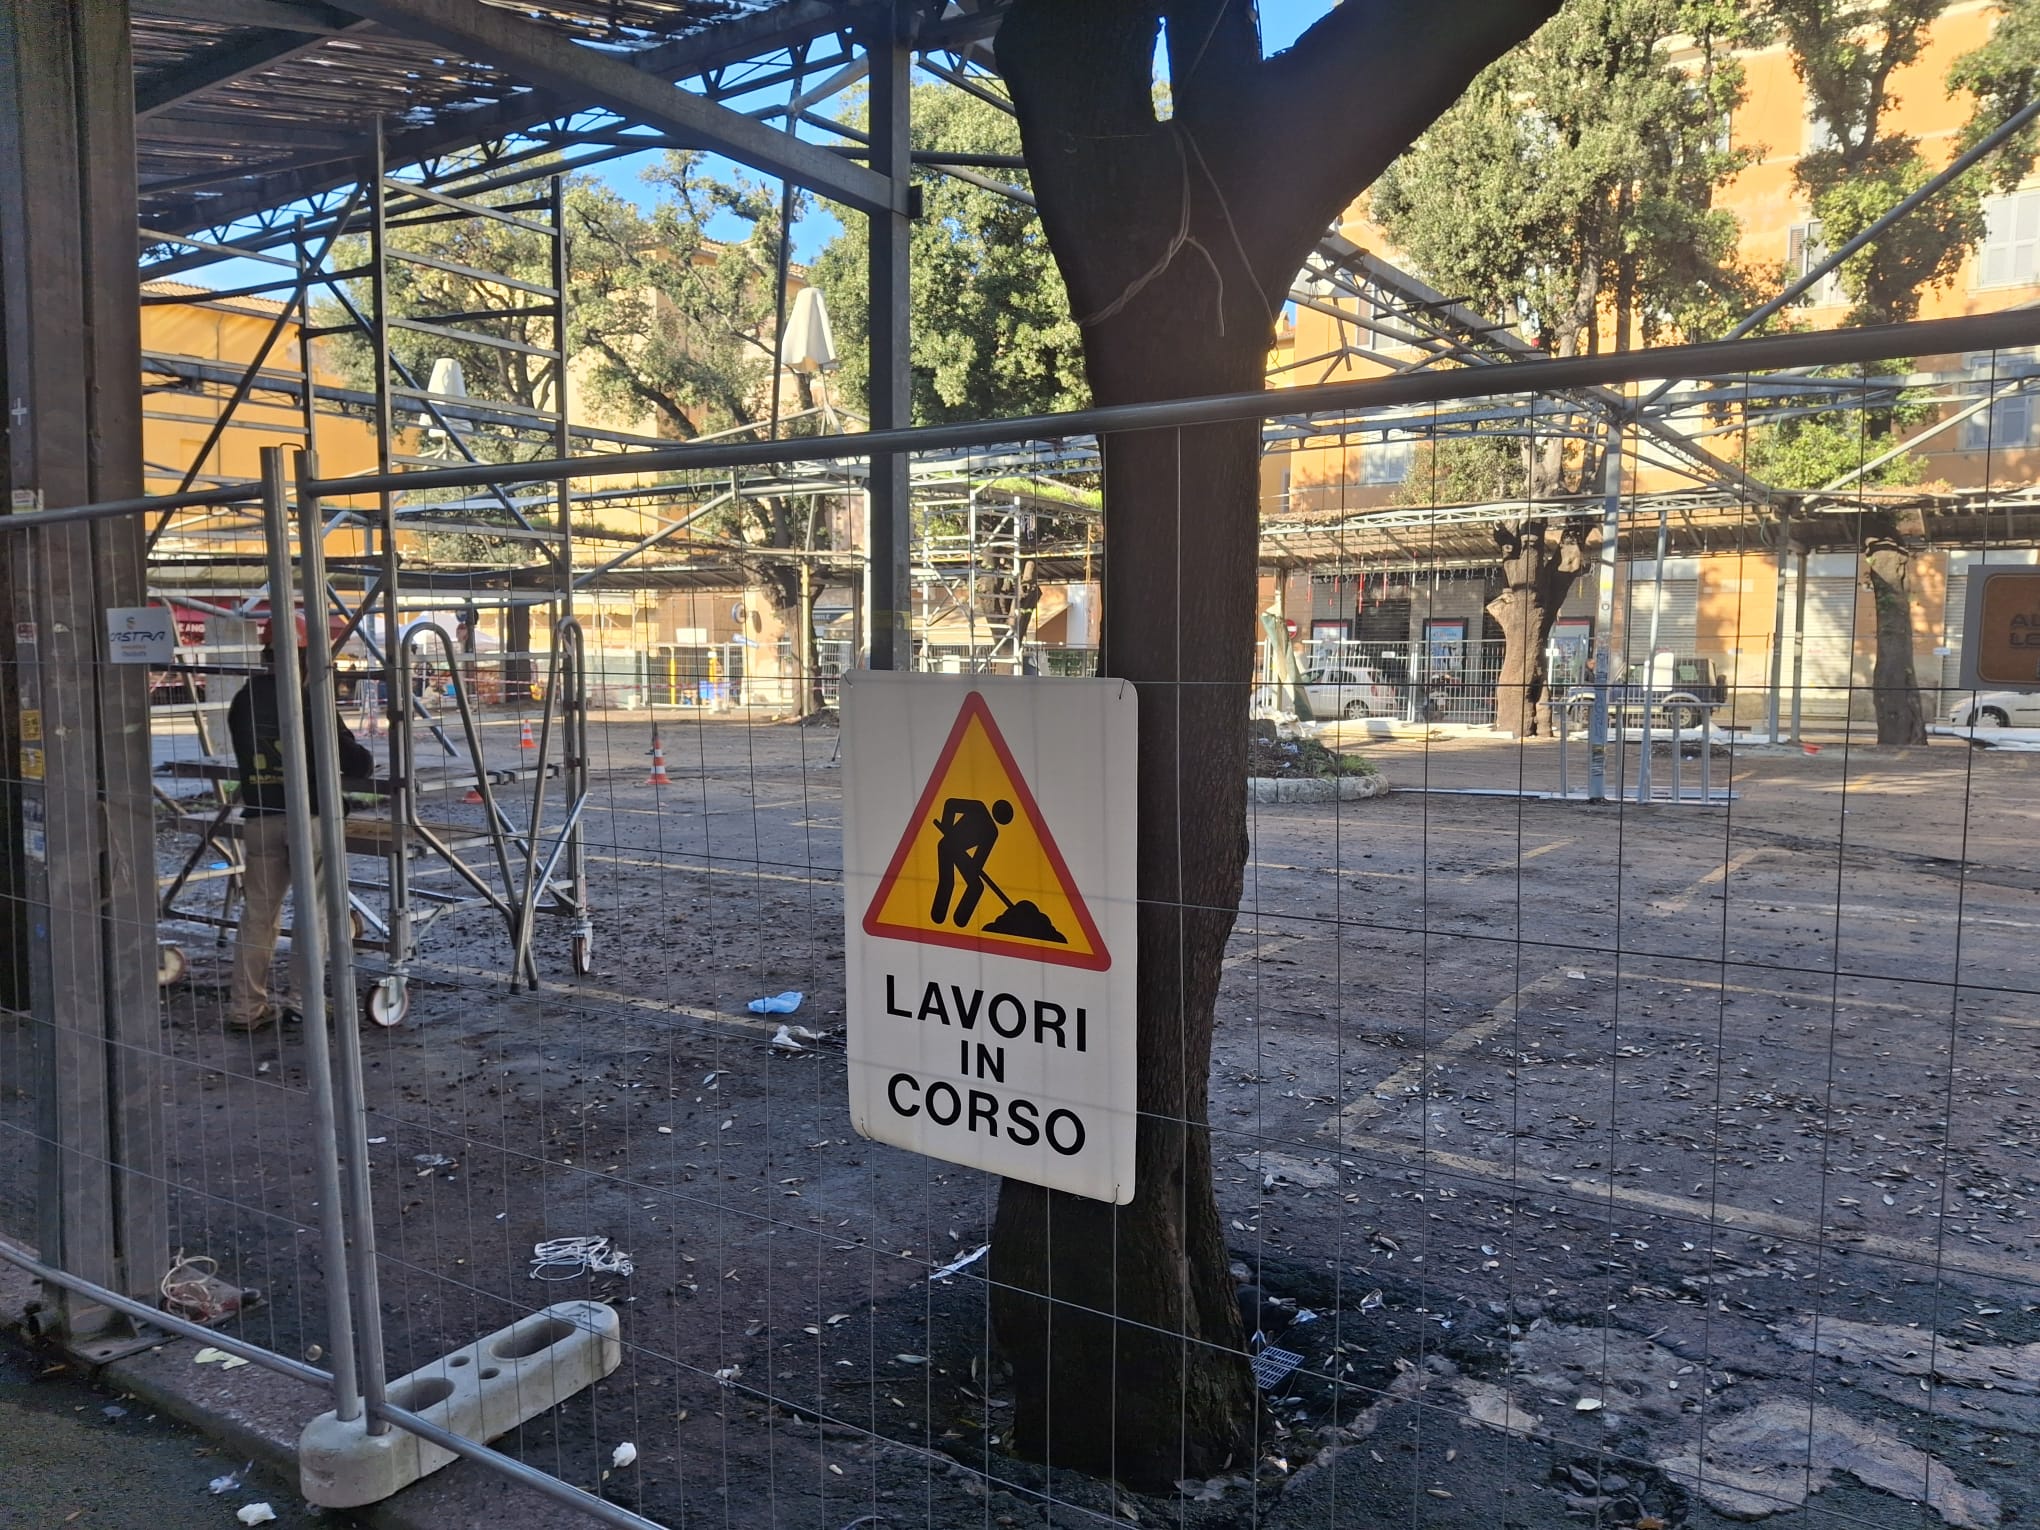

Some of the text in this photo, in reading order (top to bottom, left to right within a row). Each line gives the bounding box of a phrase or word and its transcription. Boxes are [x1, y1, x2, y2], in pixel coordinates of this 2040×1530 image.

[886, 974, 1088, 1053] LAVORI
[961, 1040, 1005, 1084] IN
[887, 1072, 1086, 1156] CORSO
